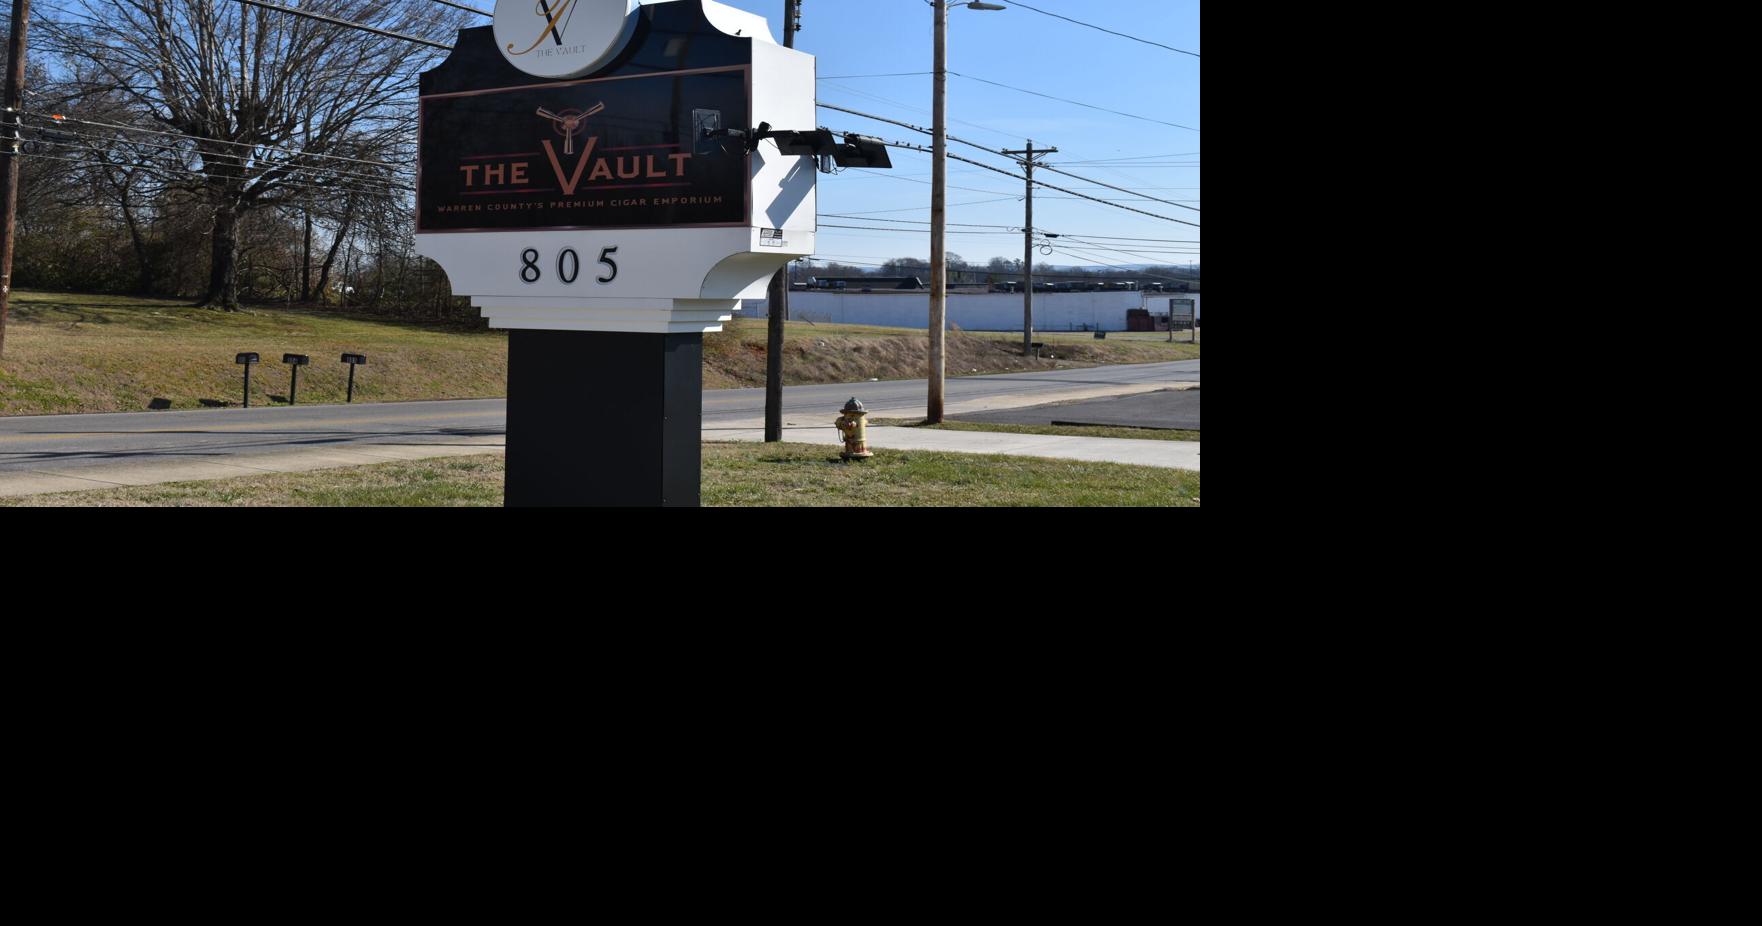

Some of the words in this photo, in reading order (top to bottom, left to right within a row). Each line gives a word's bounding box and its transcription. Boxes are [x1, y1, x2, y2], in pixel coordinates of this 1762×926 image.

[536, 49, 553, 58] THE
[555, 45, 587, 56] VAULT
[460, 162, 529, 186] THE
[541, 136, 692, 195] VAULT
[437, 203, 481, 212] WARREN
[487, 202, 544, 211] COUNTY'S
[550, 200, 604, 209] PREMIUM
[610, 198, 647, 207] CIGAR
[653, 196, 723, 206] EMPORIUM
[519, 246, 618, 284] 805
